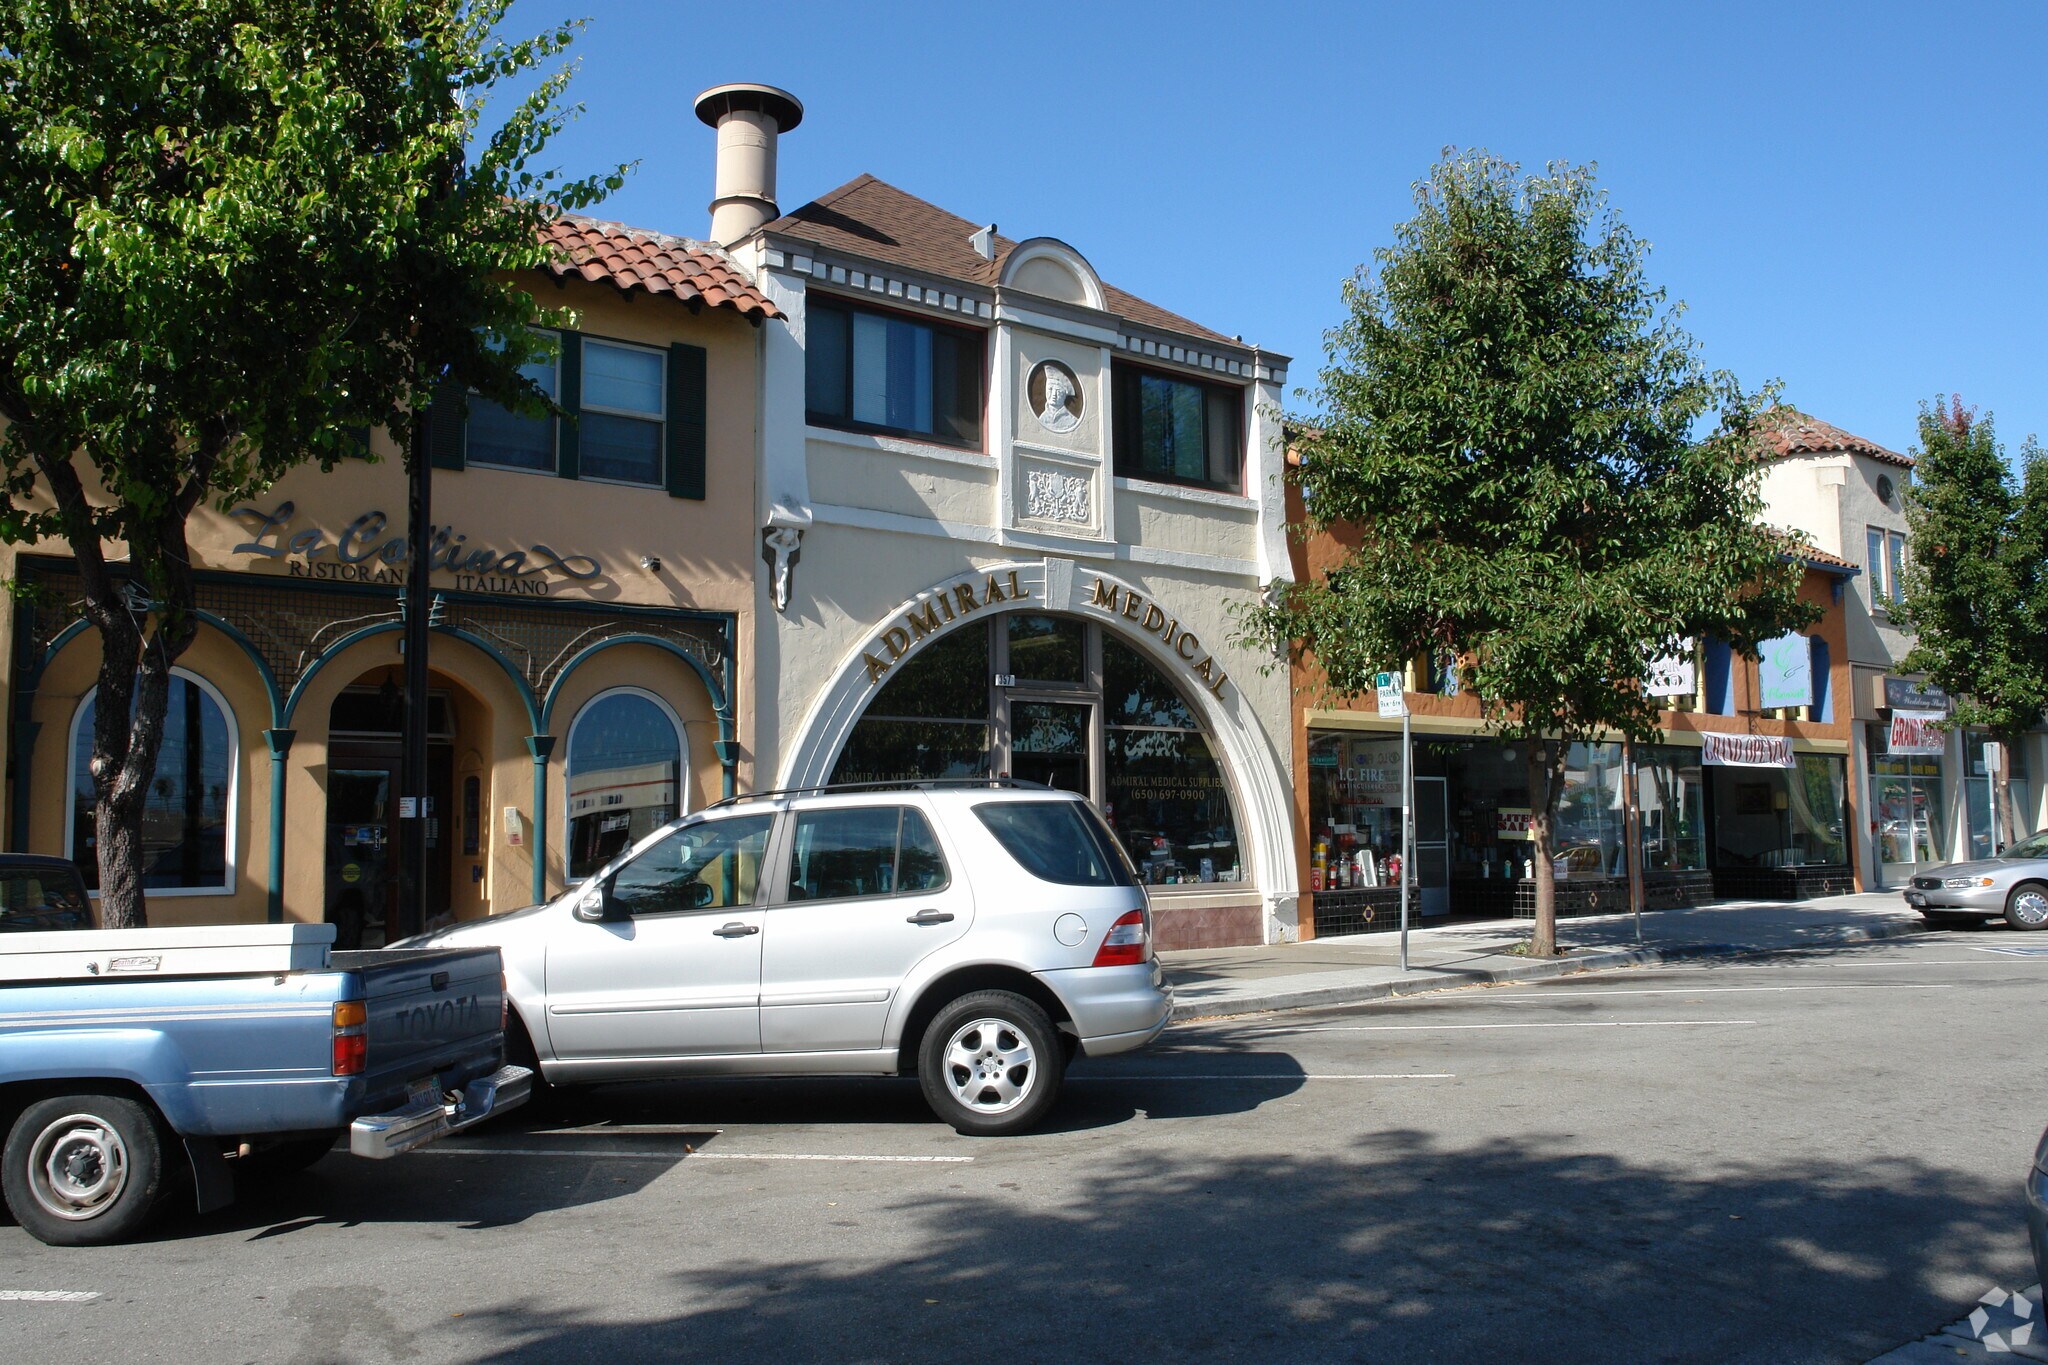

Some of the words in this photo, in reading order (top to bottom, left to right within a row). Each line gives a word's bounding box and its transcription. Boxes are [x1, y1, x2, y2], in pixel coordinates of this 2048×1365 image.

[229, 501, 328, 558] La
[289, 561, 404, 584] RISTORAN
[455, 574, 549, 596] ITALIANO
[863, 570, 1029, 684] ADMIRAL
[1091, 577, 1228, 701] MEDICAL
[1653, 661, 1681, 673] HAIR
[1903, 696, 1930, 709] Wedding
[1892, 717, 1919, 747] GRAND
[1704, 735, 1742, 762] GRAND
[1111, 776, 1149, 787] ADMIRAL
[1150, 776, 1187, 787] MEDICAL
[1188, 777, 1223, 788] SUPPLIES
[1360, 768, 1385, 782] FIRE
[1131, 789, 1157, 801] (650)
[1159, 789, 1205, 801] 697-0900
[396, 994, 480, 1036] TOYOTA
